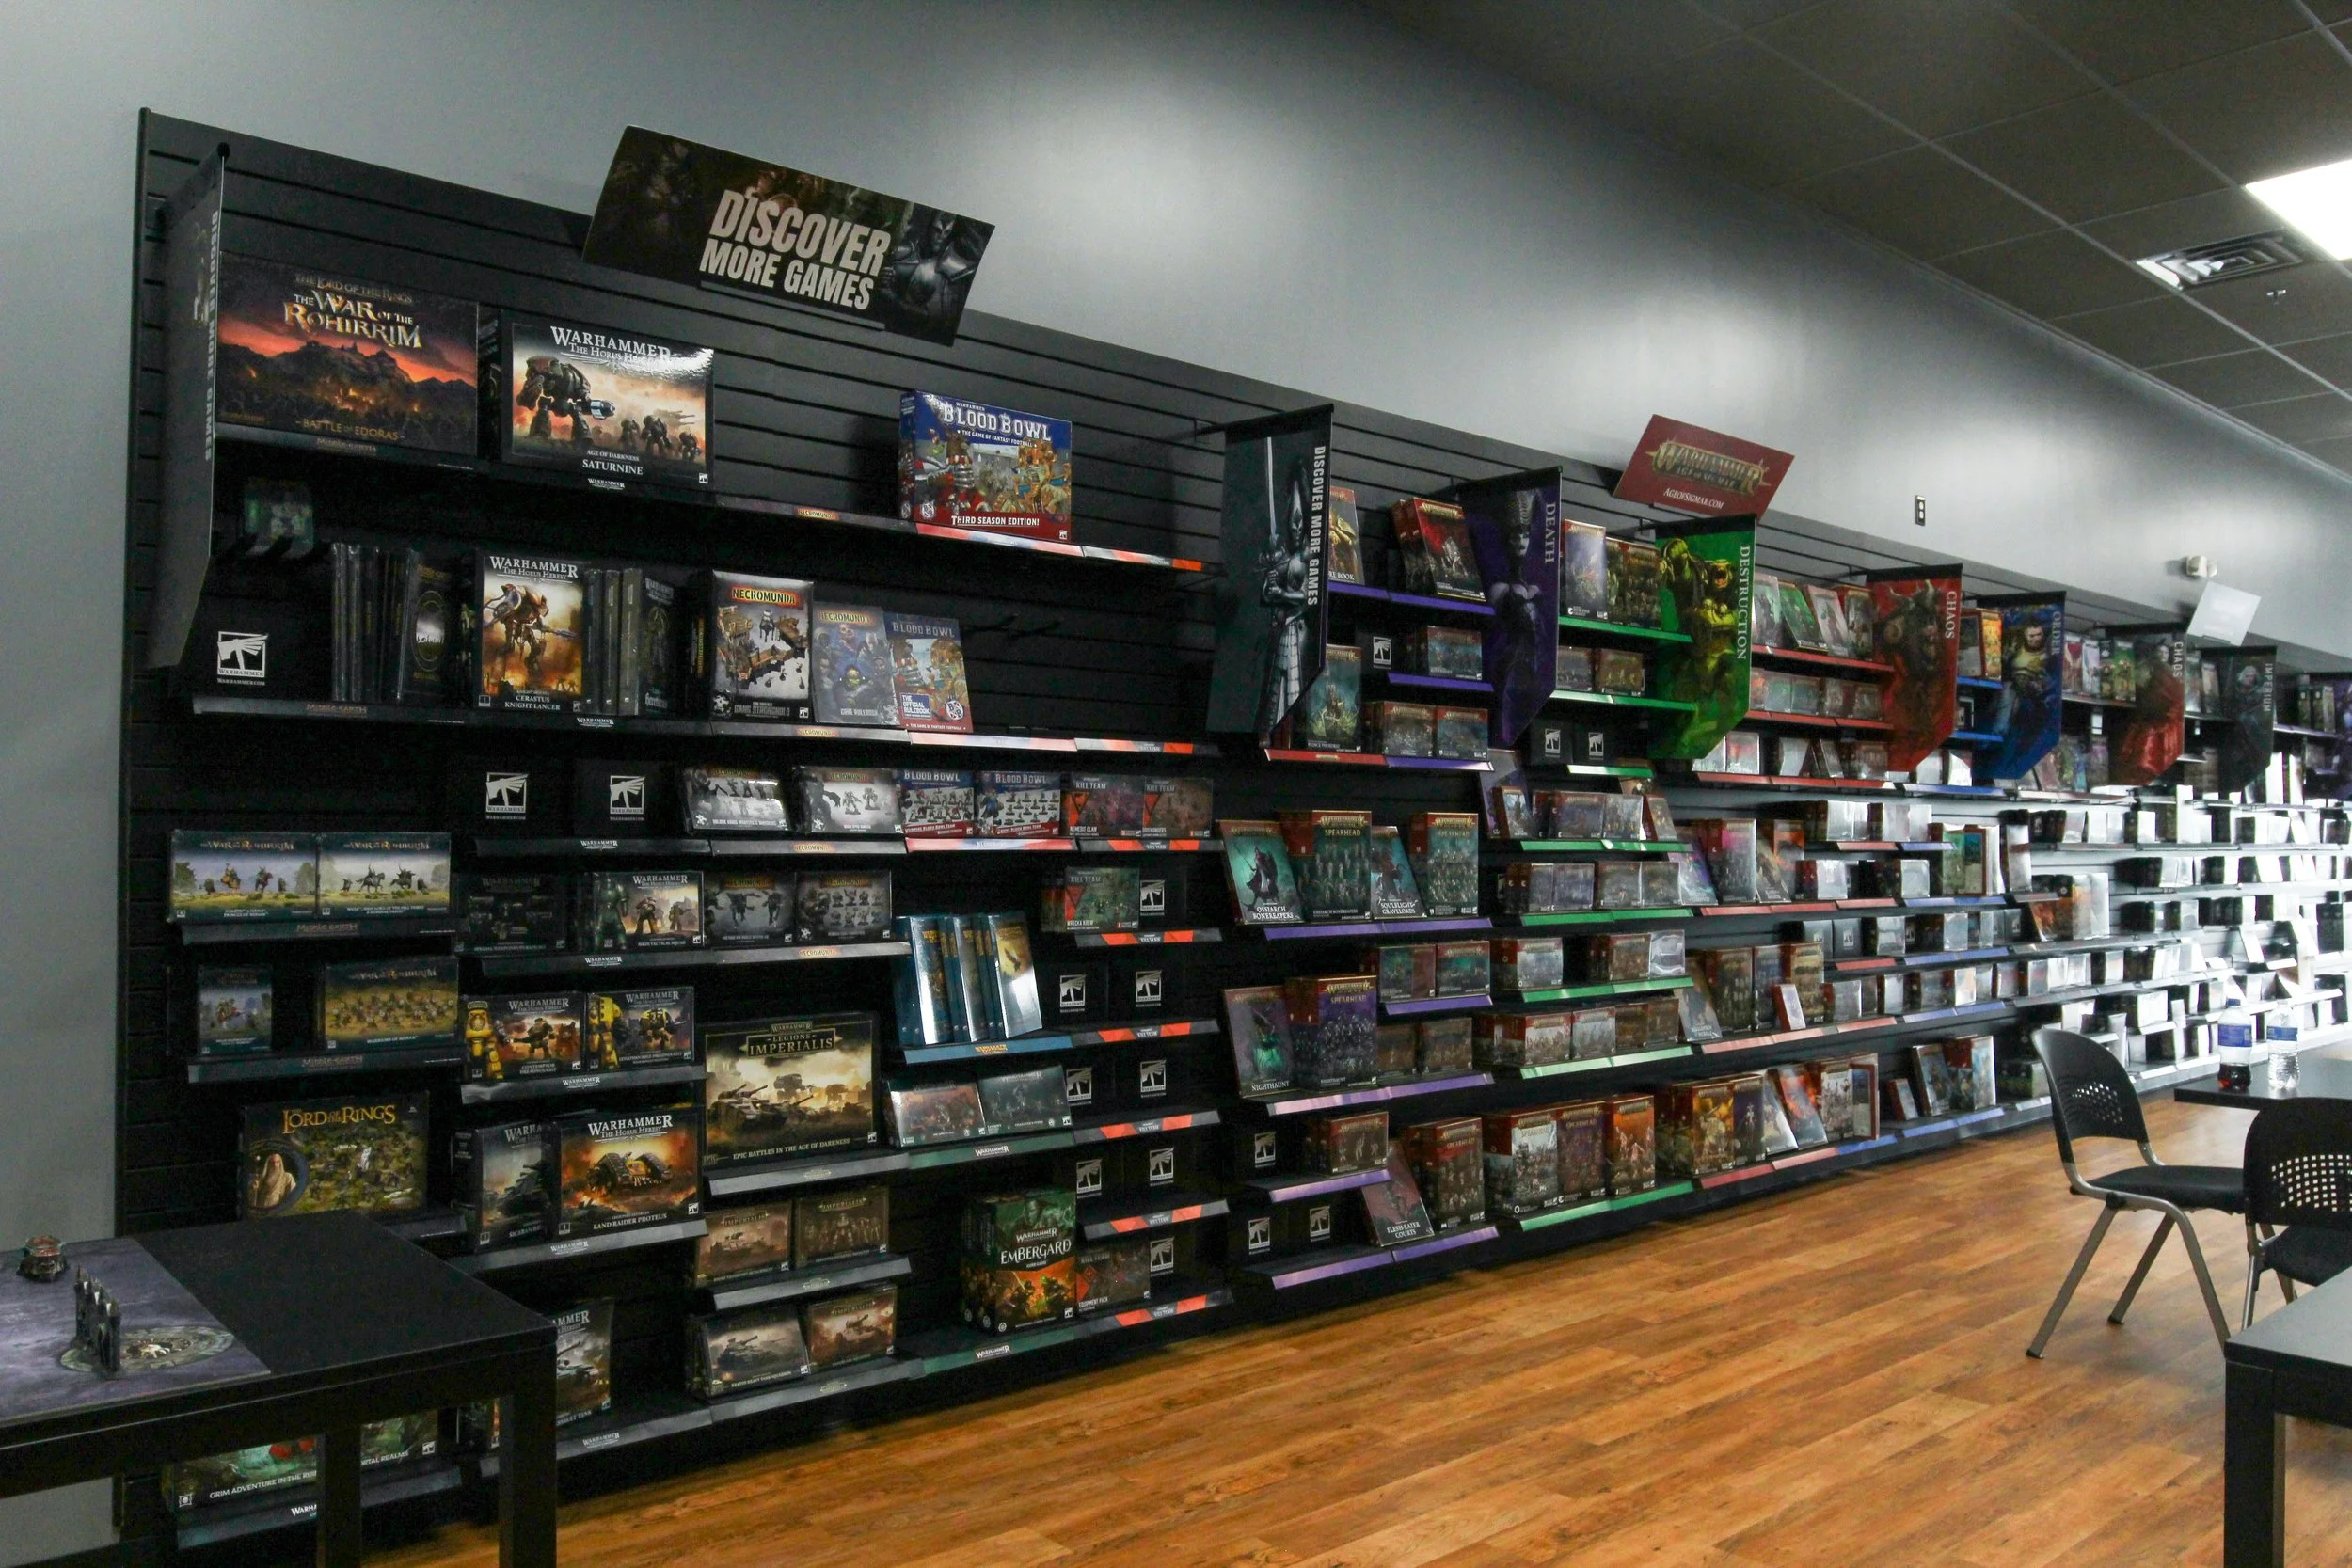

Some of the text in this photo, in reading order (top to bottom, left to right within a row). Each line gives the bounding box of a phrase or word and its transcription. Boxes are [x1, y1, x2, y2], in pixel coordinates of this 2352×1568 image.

[708, 188, 892, 277] DISCOVER
[699, 237, 875, 310] MORE GAMES
[294, 293, 314, 307] THE
[312, 290, 377, 322] WAR
[393, 313, 413, 325] THE
[283, 302, 422, 349] ROHIRRIM
[550, 326, 671, 360] WARHAMMER
[569, 342, 588, 354] THE
[590, 345, 622, 360] HORUS
[303, 418, 399, 440] BATTLE EDORAS
[942, 402, 996, 432] BLOOD
[999, 412, 1051, 441] BOWL
[992, 435, 1010, 443] FANTASY
[610, 452, 640, 461] DARKNESS
[582, 459, 644, 475] SATURNINE
[1663, 487, 1724, 509] AGEOFSIGMAR.COM
[951, 515, 976, 525] THIRD
[1008, 517, 1040, 526] EDITION!
[1308, 446, 1325, 605] DISCOVER MORE GAMES
[1544, 502, 1556, 564] DEATH
[489, 556, 579, 578] WARHAMMER
[503, 565, 516, 575] THE
[1339, 572, 1355, 580] BOOK
[732, 587, 796, 604] NECROMUNDA
[1736, 545, 1751, 659] DESTRUCTION
[1945, 591, 1958, 640] CHAOS
[894, 622, 955, 638] BLOOD BOWL
[2051, 611, 2061, 656] ORDER
[2172, 641, 2184, 678] CHAOS
[2263, 663, 2273, 713] IMPERIUM
[904, 771, 961, 781] BLOOD BOWL
[995, 774, 1047, 784] BLOOD BOWL
[1325, 829, 1361, 837] SPEARHEAD
[632, 875, 688, 884] WARHAMMER
[1253, 912, 1294, 921] BONEREAPERS
[509, 998, 569, 1010] WARHAMMER
[626, 991, 679, 1003] WARHAMMER
[750, 1038, 834, 1055] IMPERIALIS
[772, 1034, 811, 1042] LEGIONS
[1251, 1081, 1289, 1091] NIGHTHAUNT
[282, 1105, 395, 1133] LORD RINGS
[588, 1115, 673, 1136] WARHAMMER
[504, 1123, 542, 1142] WARHA
[748, 1148, 775, 1157] BATTLES
[819, 1138, 850, 1148] DARKNESS
[975, 1146, 1009, 1156] WARHAMMER
[612, 1218, 637, 1227] RAIDER
[638, 1213, 667, 1223] PROTEUS
[1016, 1227, 1057, 1243] WARHAMMER
[1395, 1229, 1417, 1239] COURTS
[1001, 1239, 1072, 1264] EMBERGARD
[552, 1310, 590, 1328] AMMER
[976, 1345, 1009, 1360] WARHAMMER
[380, 1451, 409, 1463] REALMS
[209, 1489, 230, 1498] GRIM
[231, 1479, 277, 1495] ADVENTURE
[288, 1474, 302, 1482] THE
[291, 1504, 317, 1516] WARHA
